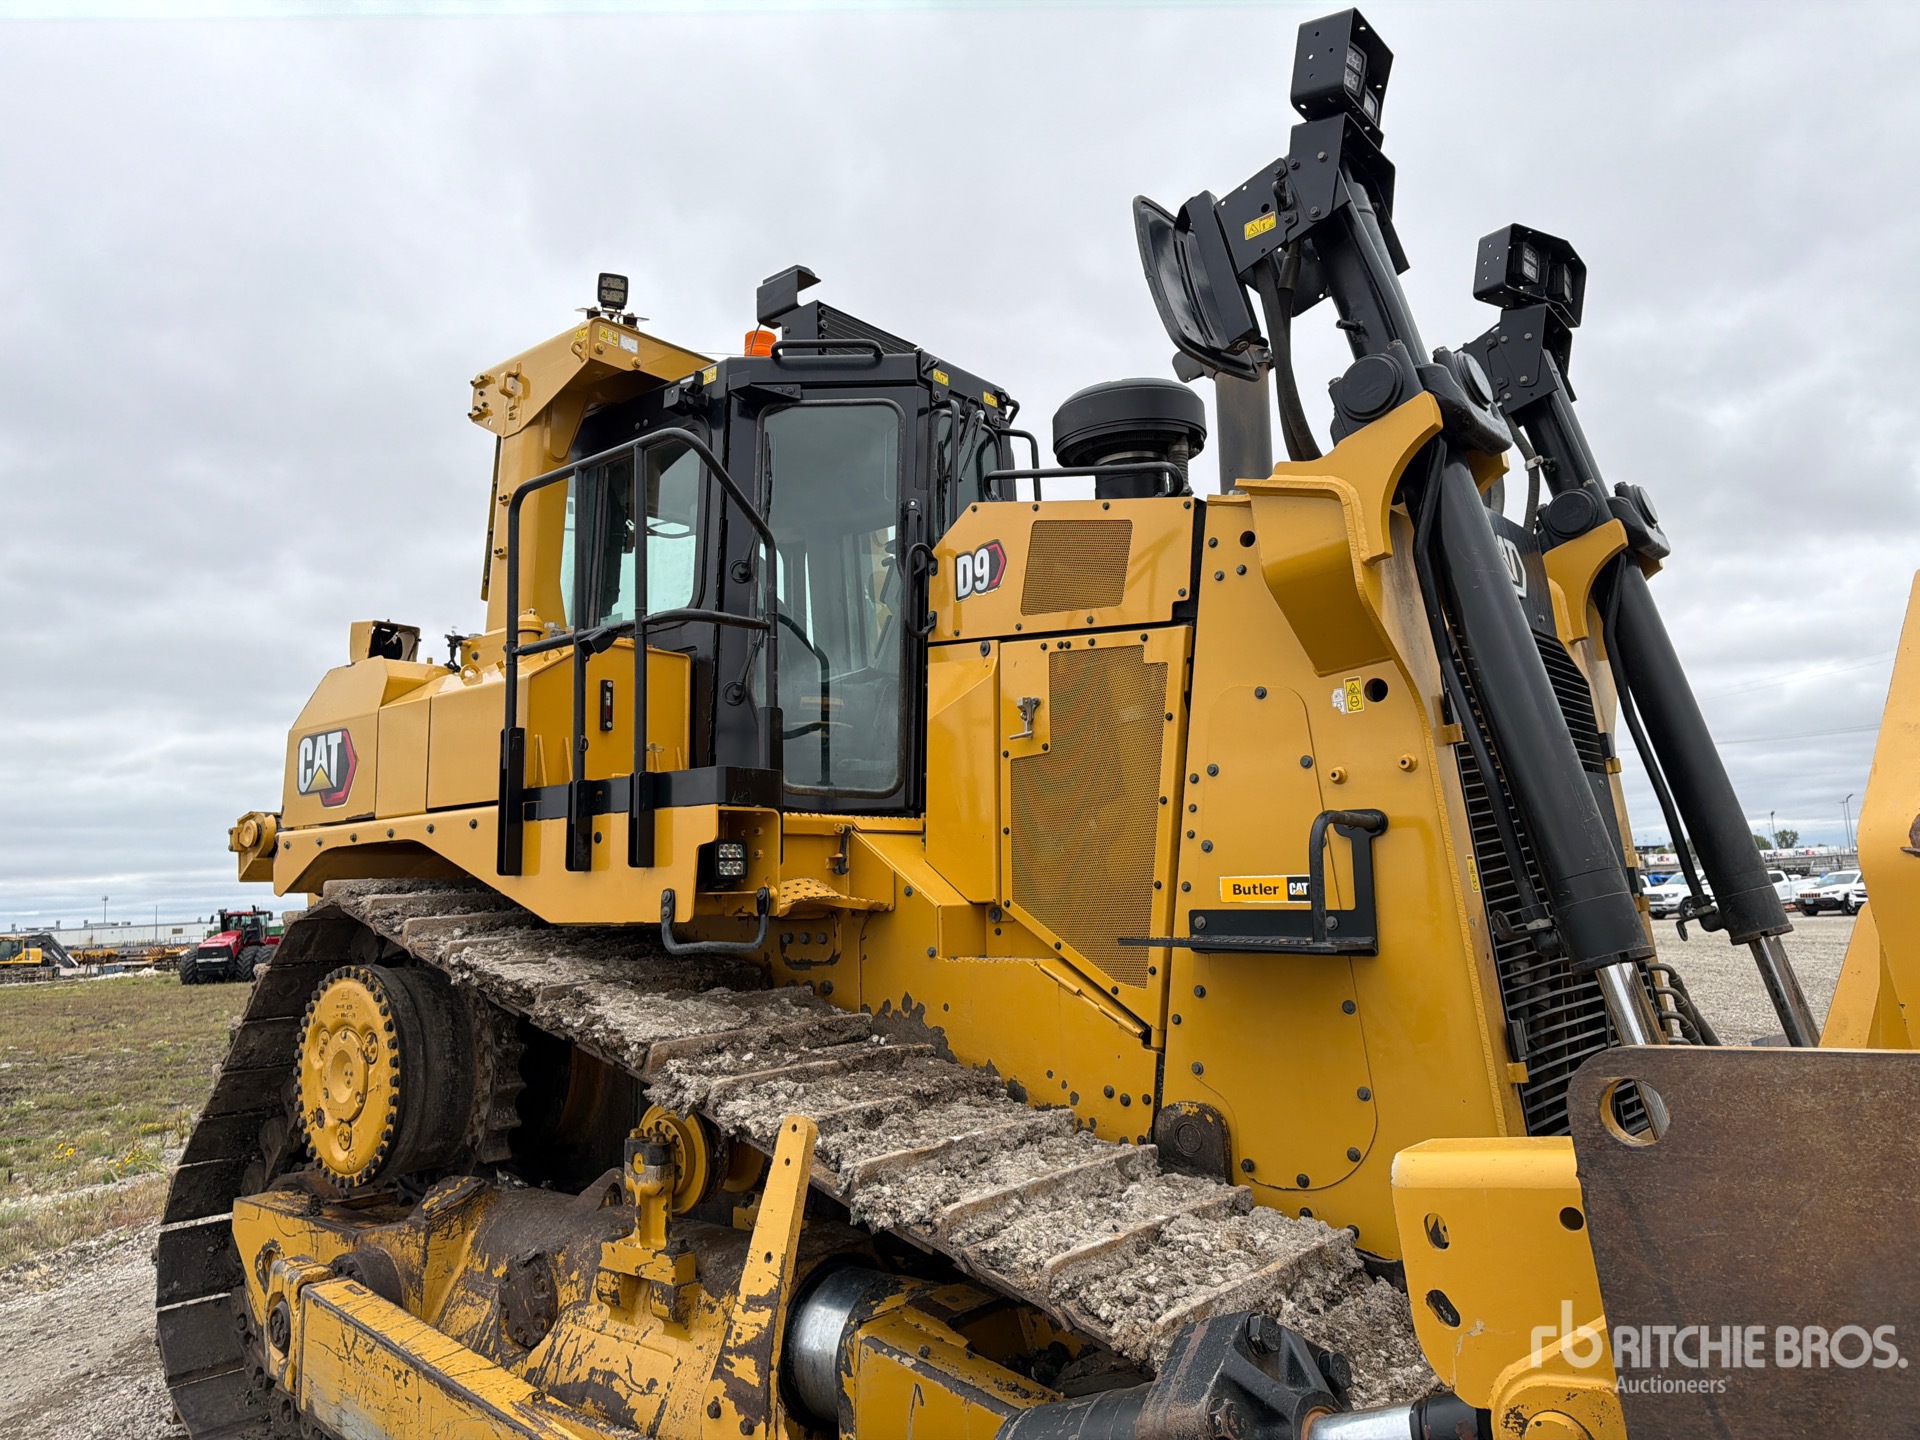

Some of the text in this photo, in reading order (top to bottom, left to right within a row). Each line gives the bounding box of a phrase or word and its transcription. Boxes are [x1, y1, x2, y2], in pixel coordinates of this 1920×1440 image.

[956, 547, 990, 598] D9
[298, 731, 342, 793] CAT
[1232, 882, 1309, 895] Butler CAT
